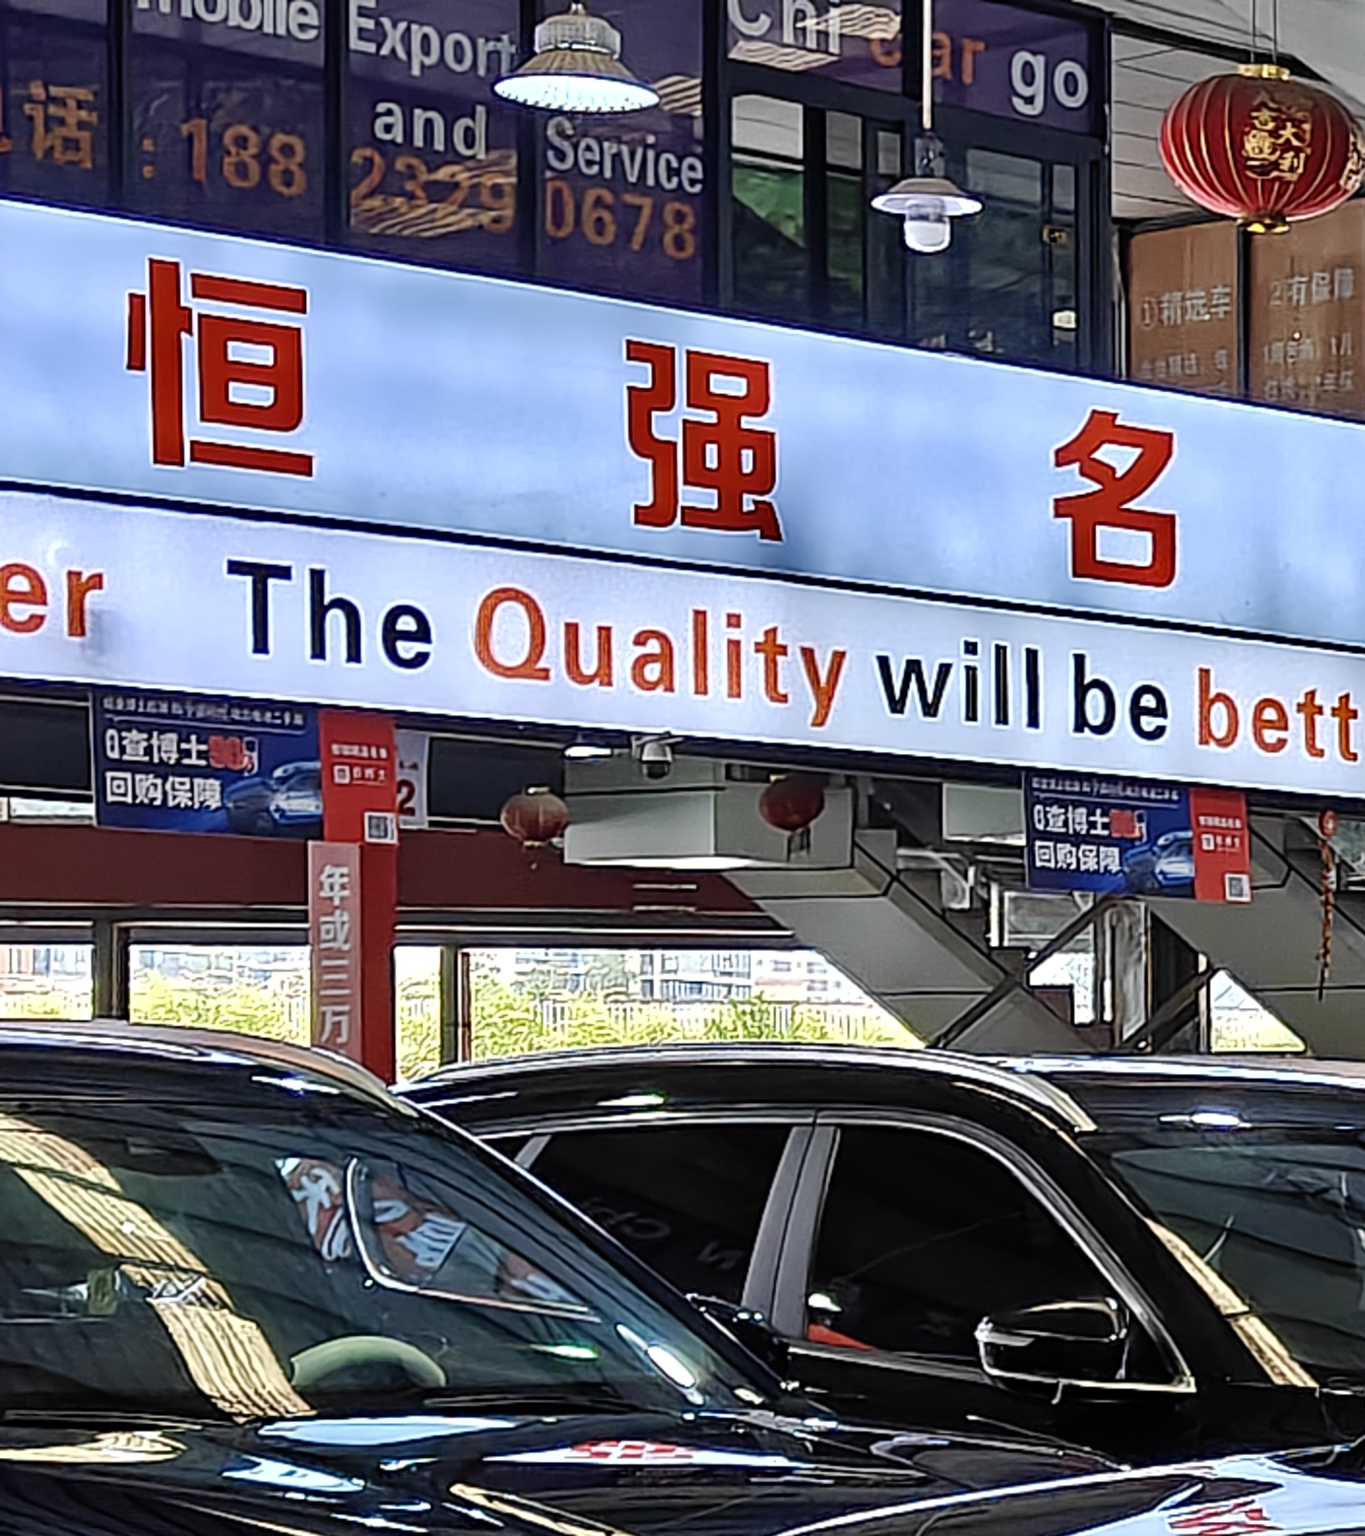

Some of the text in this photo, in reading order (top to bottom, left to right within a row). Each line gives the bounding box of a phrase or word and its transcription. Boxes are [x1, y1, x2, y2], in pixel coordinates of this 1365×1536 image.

[135, 0, 321, 40] obile
[350, 0, 517, 77] Export
[1011, 49, 1089, 116] go
[374, 101, 487, 159] and
[546, 115, 703, 195] Service
[545, 179, 695, 260] 0678
[226, 559, 433, 670] The
[474, 587, 847, 727] Quality
[877, 640, 1040, 730] will
[1072, 652, 1168, 741] be
[105, 771, 223, 811] 回购保障
[319, 864, 352, 1044] 年或三万
